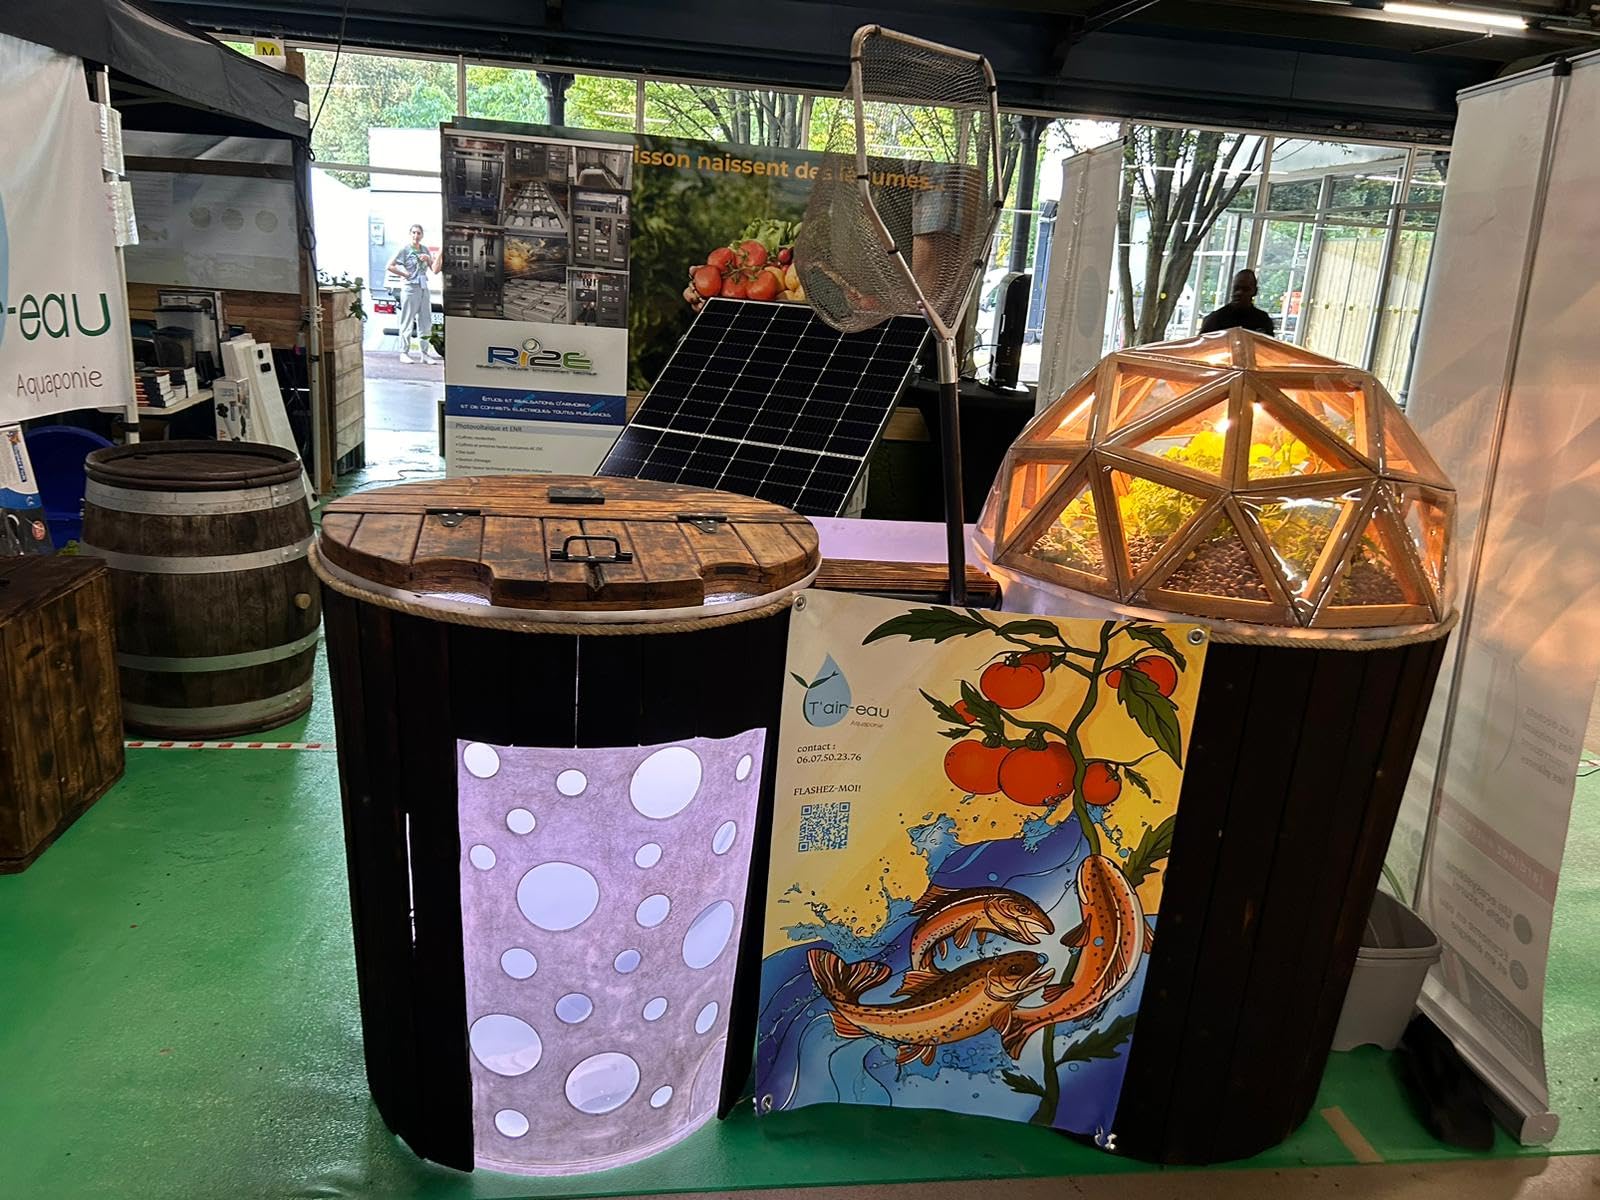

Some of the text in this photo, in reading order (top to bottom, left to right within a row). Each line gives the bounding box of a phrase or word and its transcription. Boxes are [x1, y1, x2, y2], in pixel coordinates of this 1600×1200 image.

[262, 46, 275, 56] M
[634, 144, 690, 168] isson
[697, 153, 789, 177] naissent
[0, 293, 111, 341] -eau
[16, 365, 104, 402] Aquaponie
[808, 701, 890, 719] T'air-eau
[797, 743, 831, 753] contact
[796, 753, 862, 765] 06.07.50.23.76
[793, 784, 862, 796] FLASHEZ-MOI!
